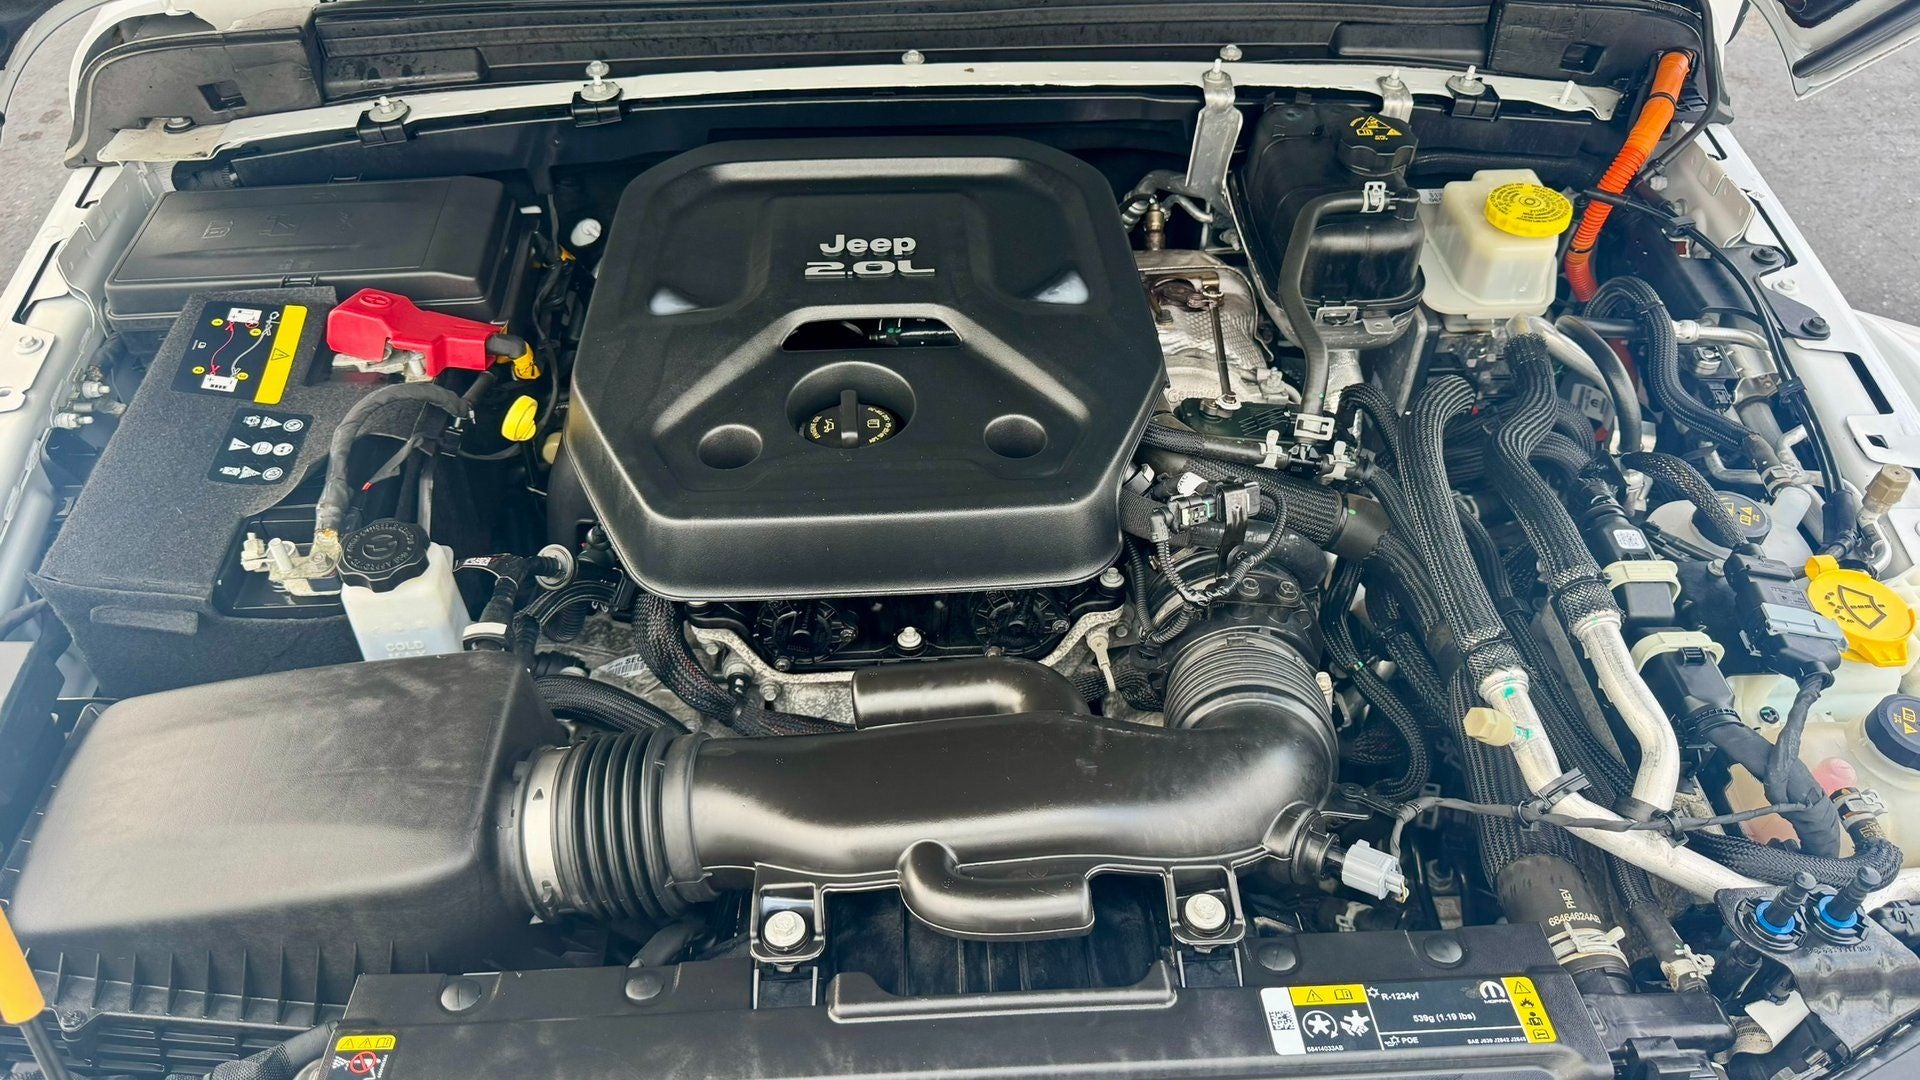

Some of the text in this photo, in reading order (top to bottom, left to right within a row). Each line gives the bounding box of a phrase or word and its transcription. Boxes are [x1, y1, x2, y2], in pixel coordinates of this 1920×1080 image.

[820, 234, 917, 257] Jeep
[804, 260, 935, 278] 2.0L
[385, 640, 425, 652] COLD
[1558, 888, 1577, 909] PHEV
[1381, 991, 1420, 1001] R-1234yf
[1412, 1012, 1476, 1023] 539g (1.19 lbs)
[1400, 1036, 1419, 1044] POE
